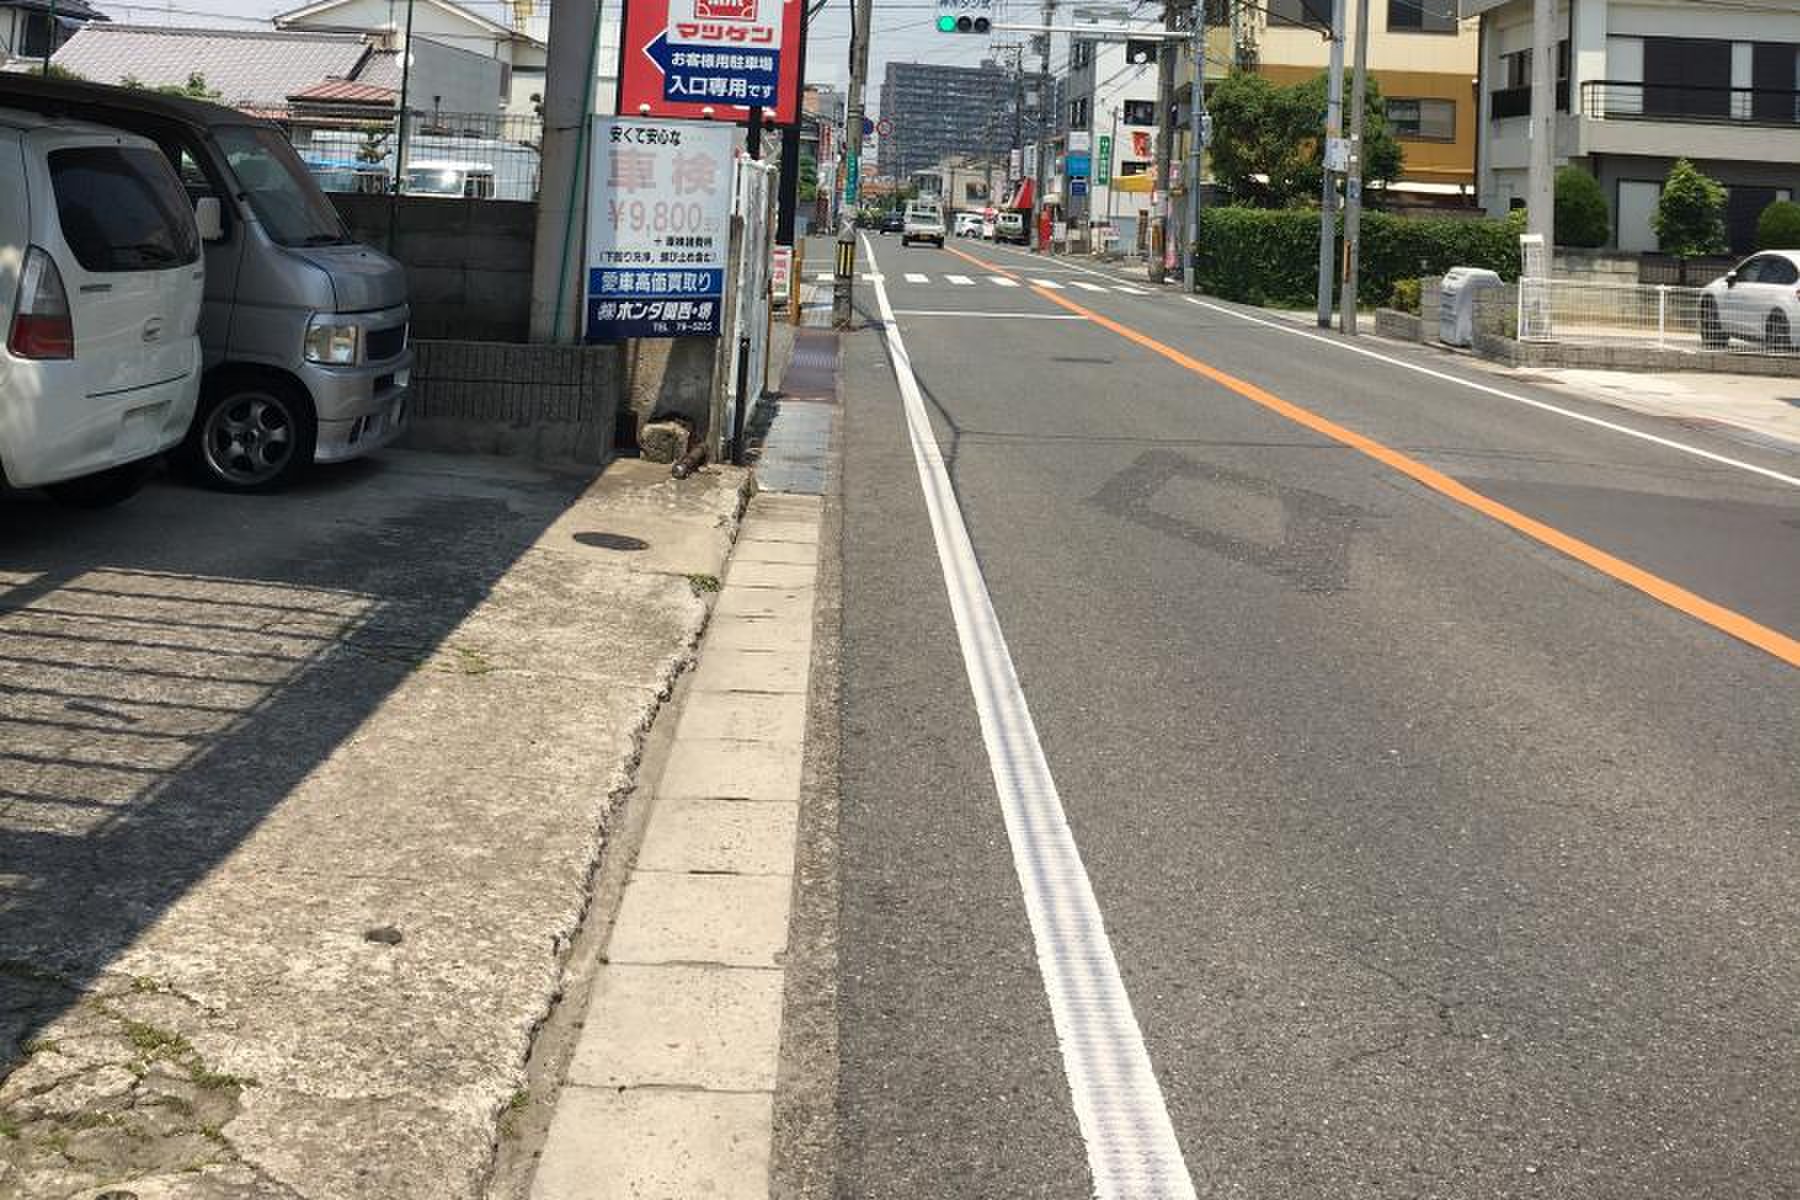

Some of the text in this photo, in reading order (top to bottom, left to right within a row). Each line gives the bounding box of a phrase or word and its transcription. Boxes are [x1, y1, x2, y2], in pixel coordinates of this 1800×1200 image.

[671, 52, 774, 72] お客様用駐車場
[669, 75, 774, 98] 入口専用です
[601, 271, 711, 293] 愛車高価買取り
